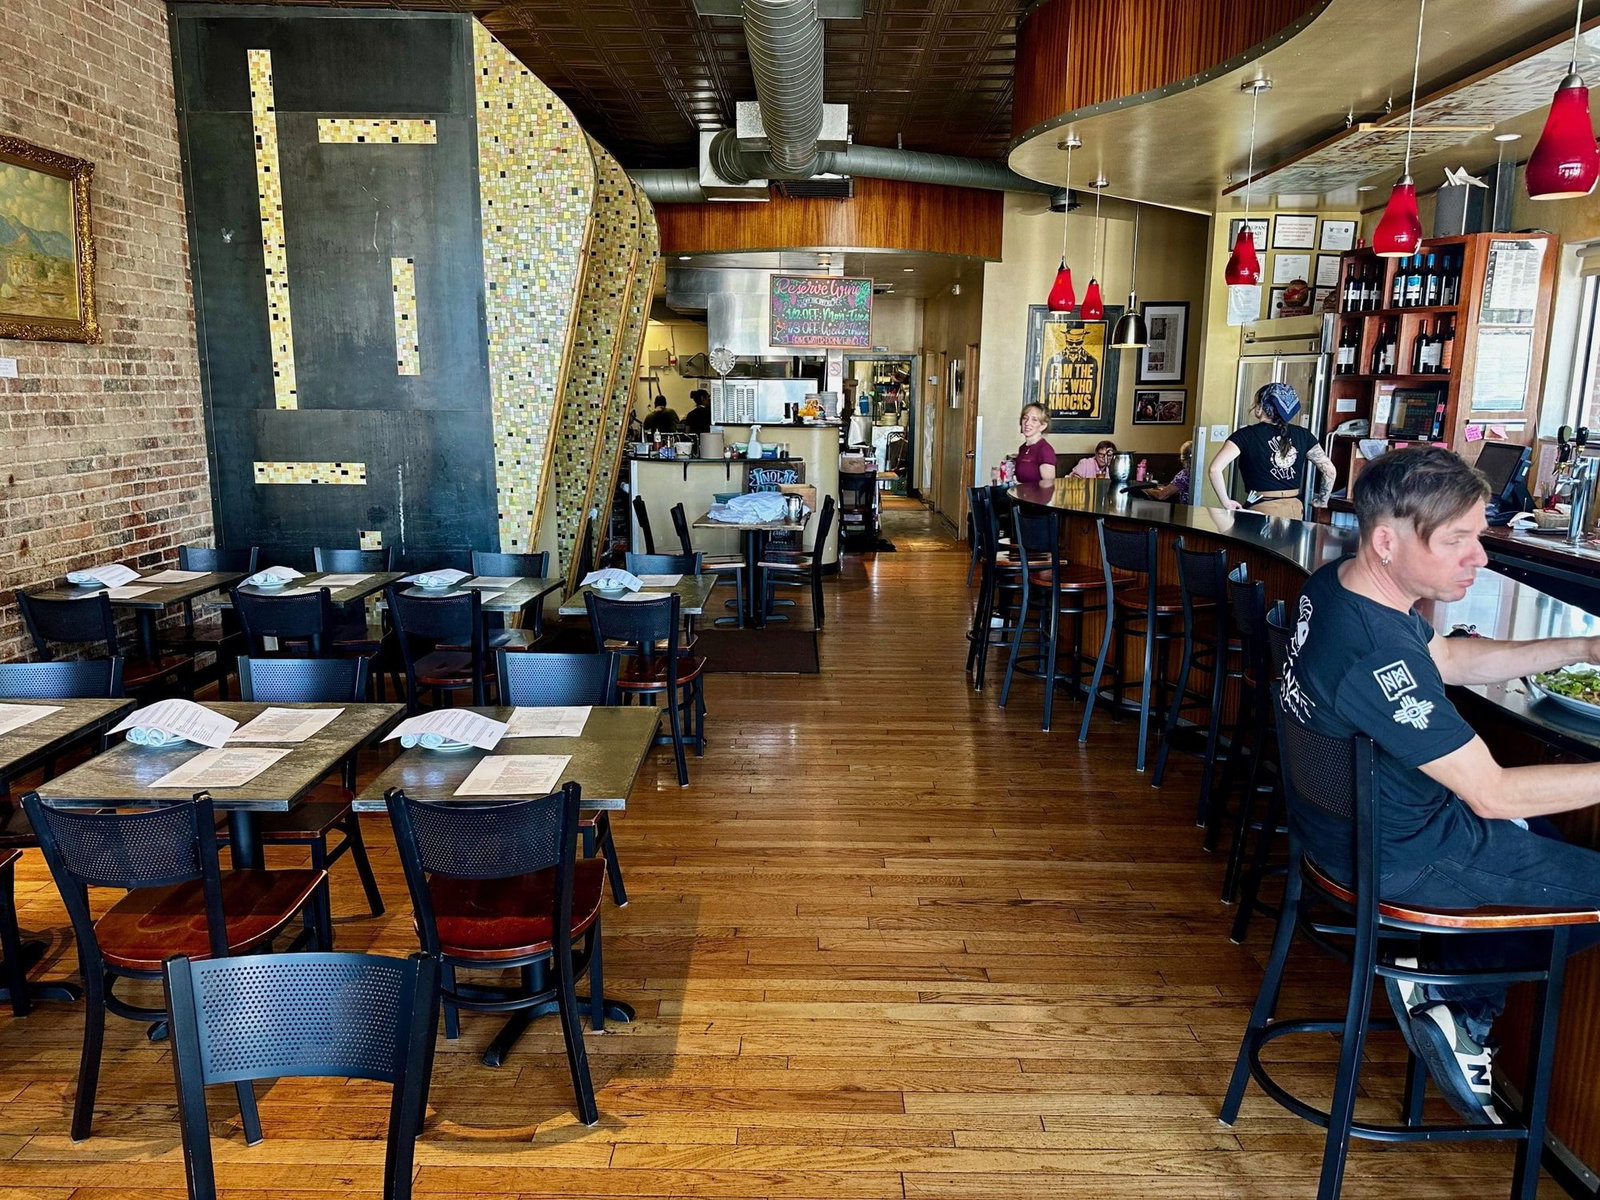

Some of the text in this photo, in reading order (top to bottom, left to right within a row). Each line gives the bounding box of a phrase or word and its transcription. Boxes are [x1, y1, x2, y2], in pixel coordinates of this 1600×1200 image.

[776, 278, 861, 298] Reserve Wine
[1055, 363, 1073, 378] AM
[1075, 363, 1094, 378] THE
[1050, 379, 1093, 394] ONE WHO
[1048, 394, 1091, 410] KNOCKS
[762, 471, 786, 483] NOW
[1270, 466, 1296, 480] PIZZA
